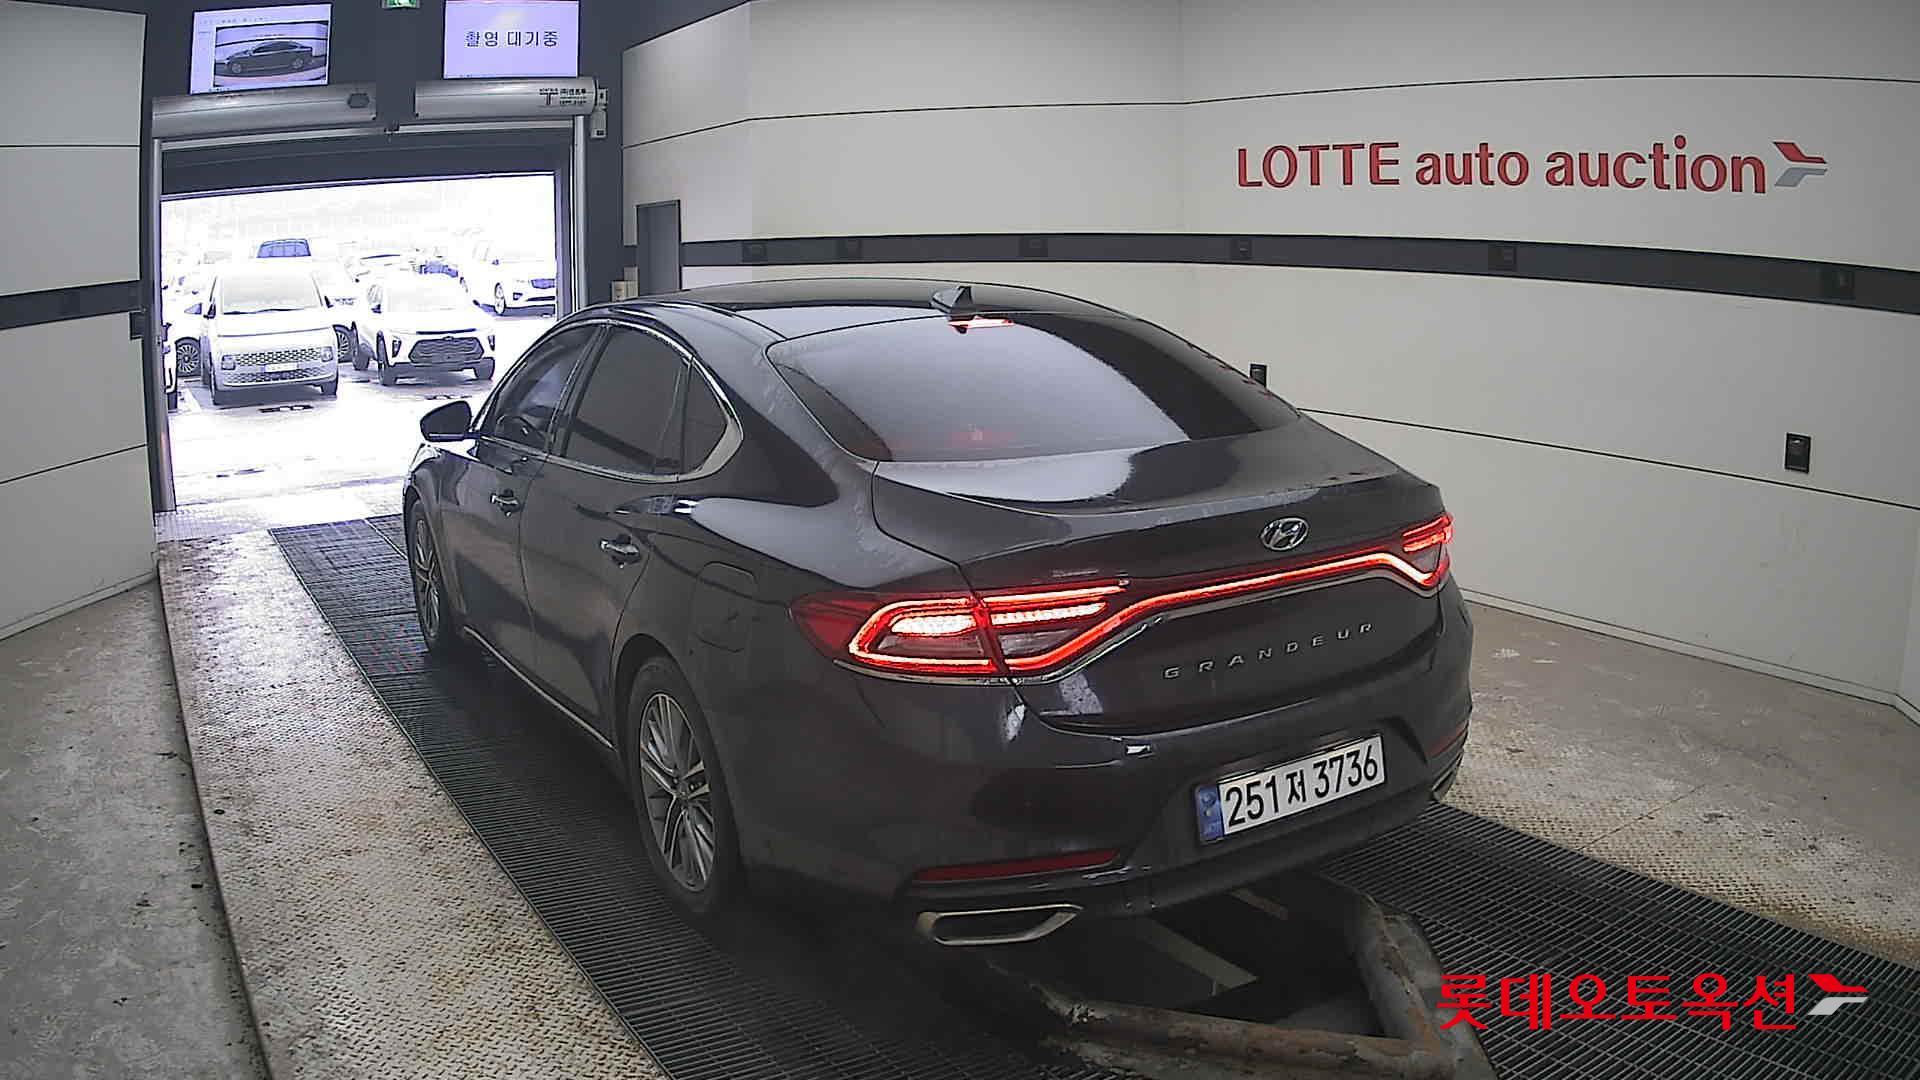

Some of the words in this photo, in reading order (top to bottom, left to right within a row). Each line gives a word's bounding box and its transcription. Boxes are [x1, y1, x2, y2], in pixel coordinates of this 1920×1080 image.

[464, 31, 499, 48] 촬영
[507, 31, 559, 48] 대기중
[1237, 142, 1400, 188] LOTTE
[1415, 143, 1529, 186] auto
[1545, 135, 1766, 194] auction
[1163, 622, 1374, 680] GRANDEUR
